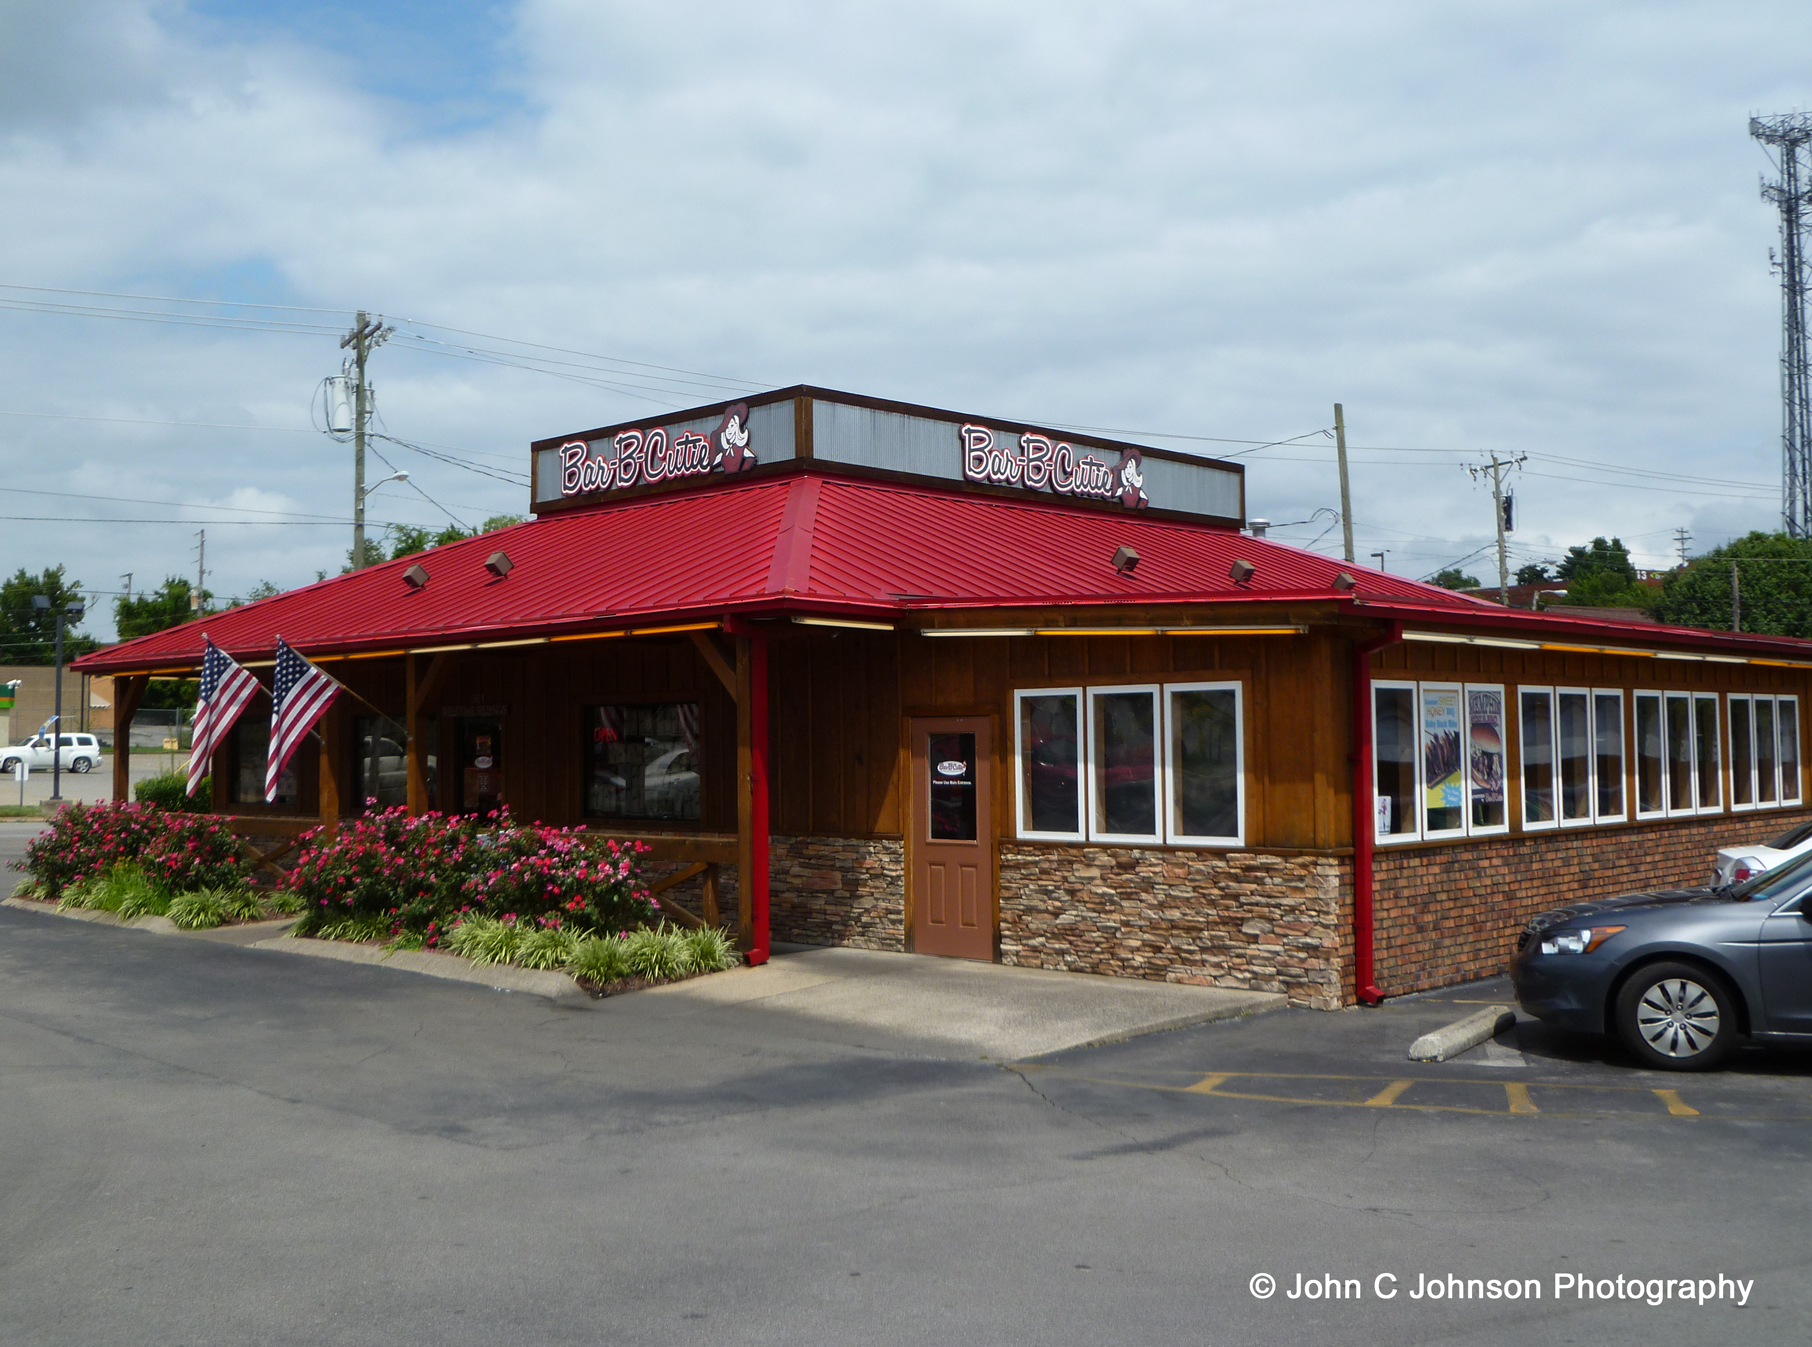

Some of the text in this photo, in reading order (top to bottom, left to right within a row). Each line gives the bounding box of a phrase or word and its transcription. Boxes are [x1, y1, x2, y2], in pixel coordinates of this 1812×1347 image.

[559, 426, 711, 496] Bar-B-Cutie
[960, 423, 1114, 499] Bar-B-Cutie
[1439, 696, 1456, 706] SWEET
[1427, 706, 1445, 717] HONEY
[593, 727, 617, 743] OPEN
